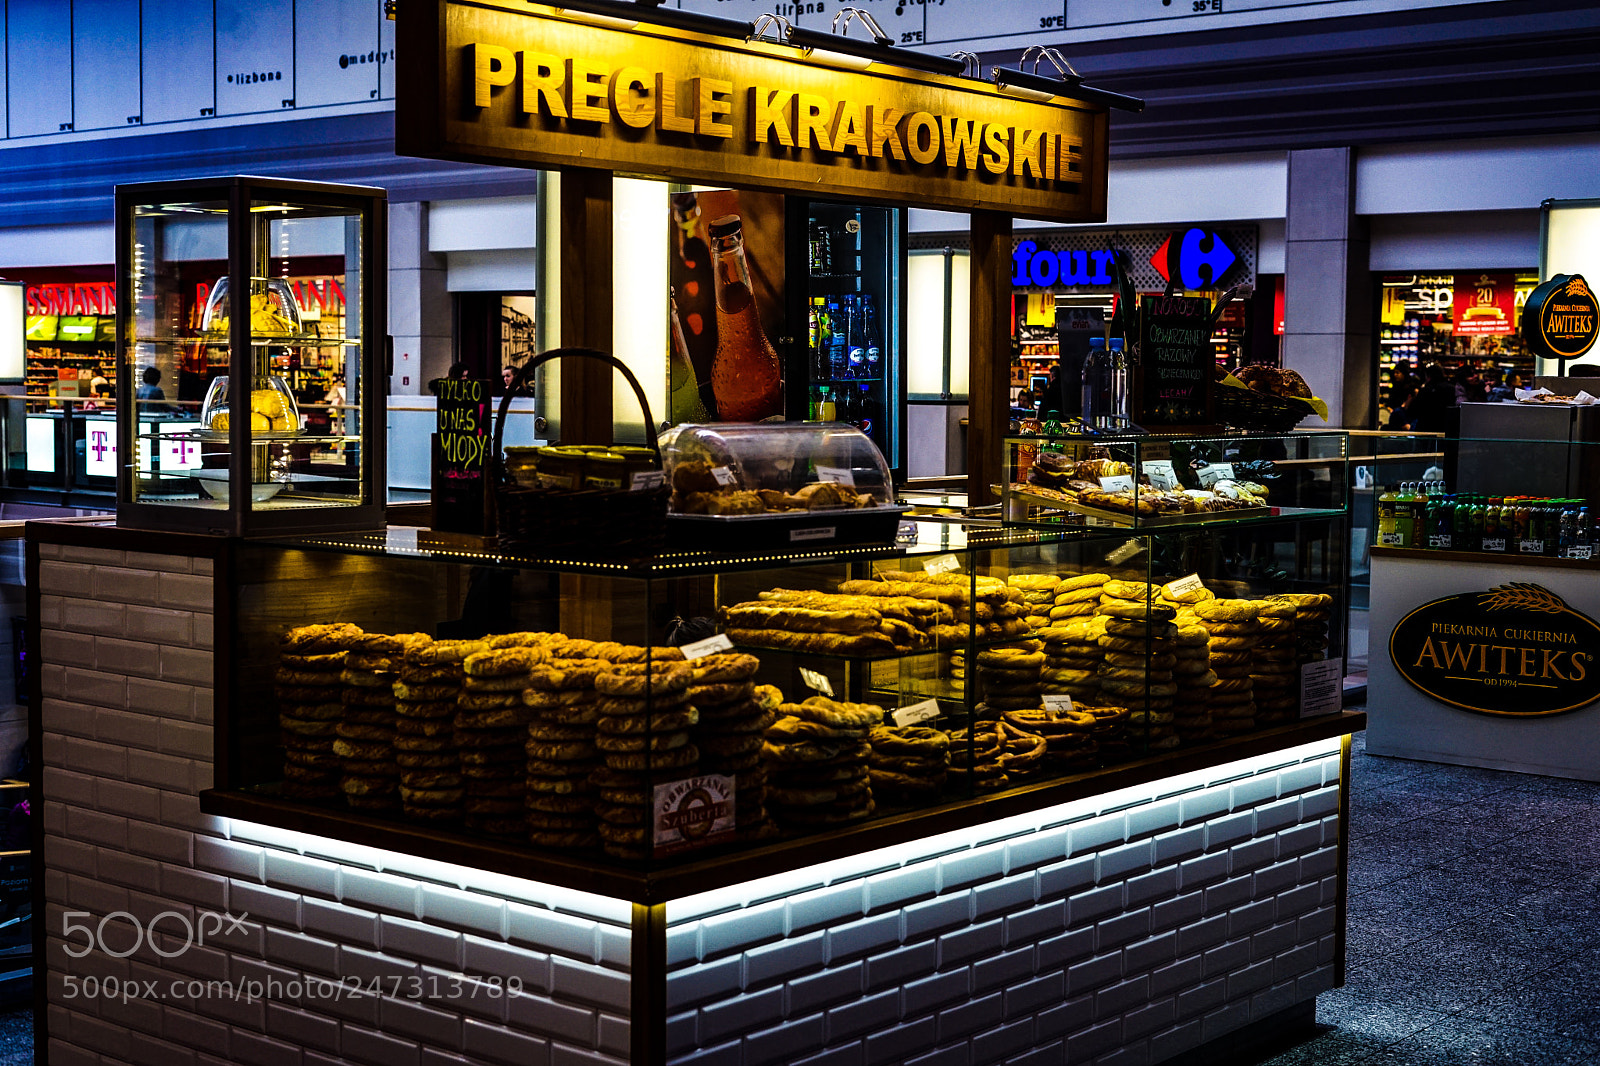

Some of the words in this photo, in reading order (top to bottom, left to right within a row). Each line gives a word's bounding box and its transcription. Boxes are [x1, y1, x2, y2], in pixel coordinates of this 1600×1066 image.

[776, 2, 825, 16] tirana
[1040, 16, 1064, 28] 30°E
[901, 31, 923, 43] 25°E
[236, 71, 282, 85] lizbona
[467, 42, 734, 139] PRECLE
[748, 86, 1085, 184] KRAKOWSKIE
[1012, 239, 1120, 287] four
[1476, 287, 1493, 303] 20
[1547, 312, 1593, 333] AWITEKS
[438, 379, 482, 402] TYLKO
[440, 408, 448, 431] U
[1431, 622, 1498, 637] PIEKARNIA
[1504, 628, 1577, 645] CUKIERNIA
[1484, 677, 1498, 687] OD
[1499, 678, 1518, 688] 1994
